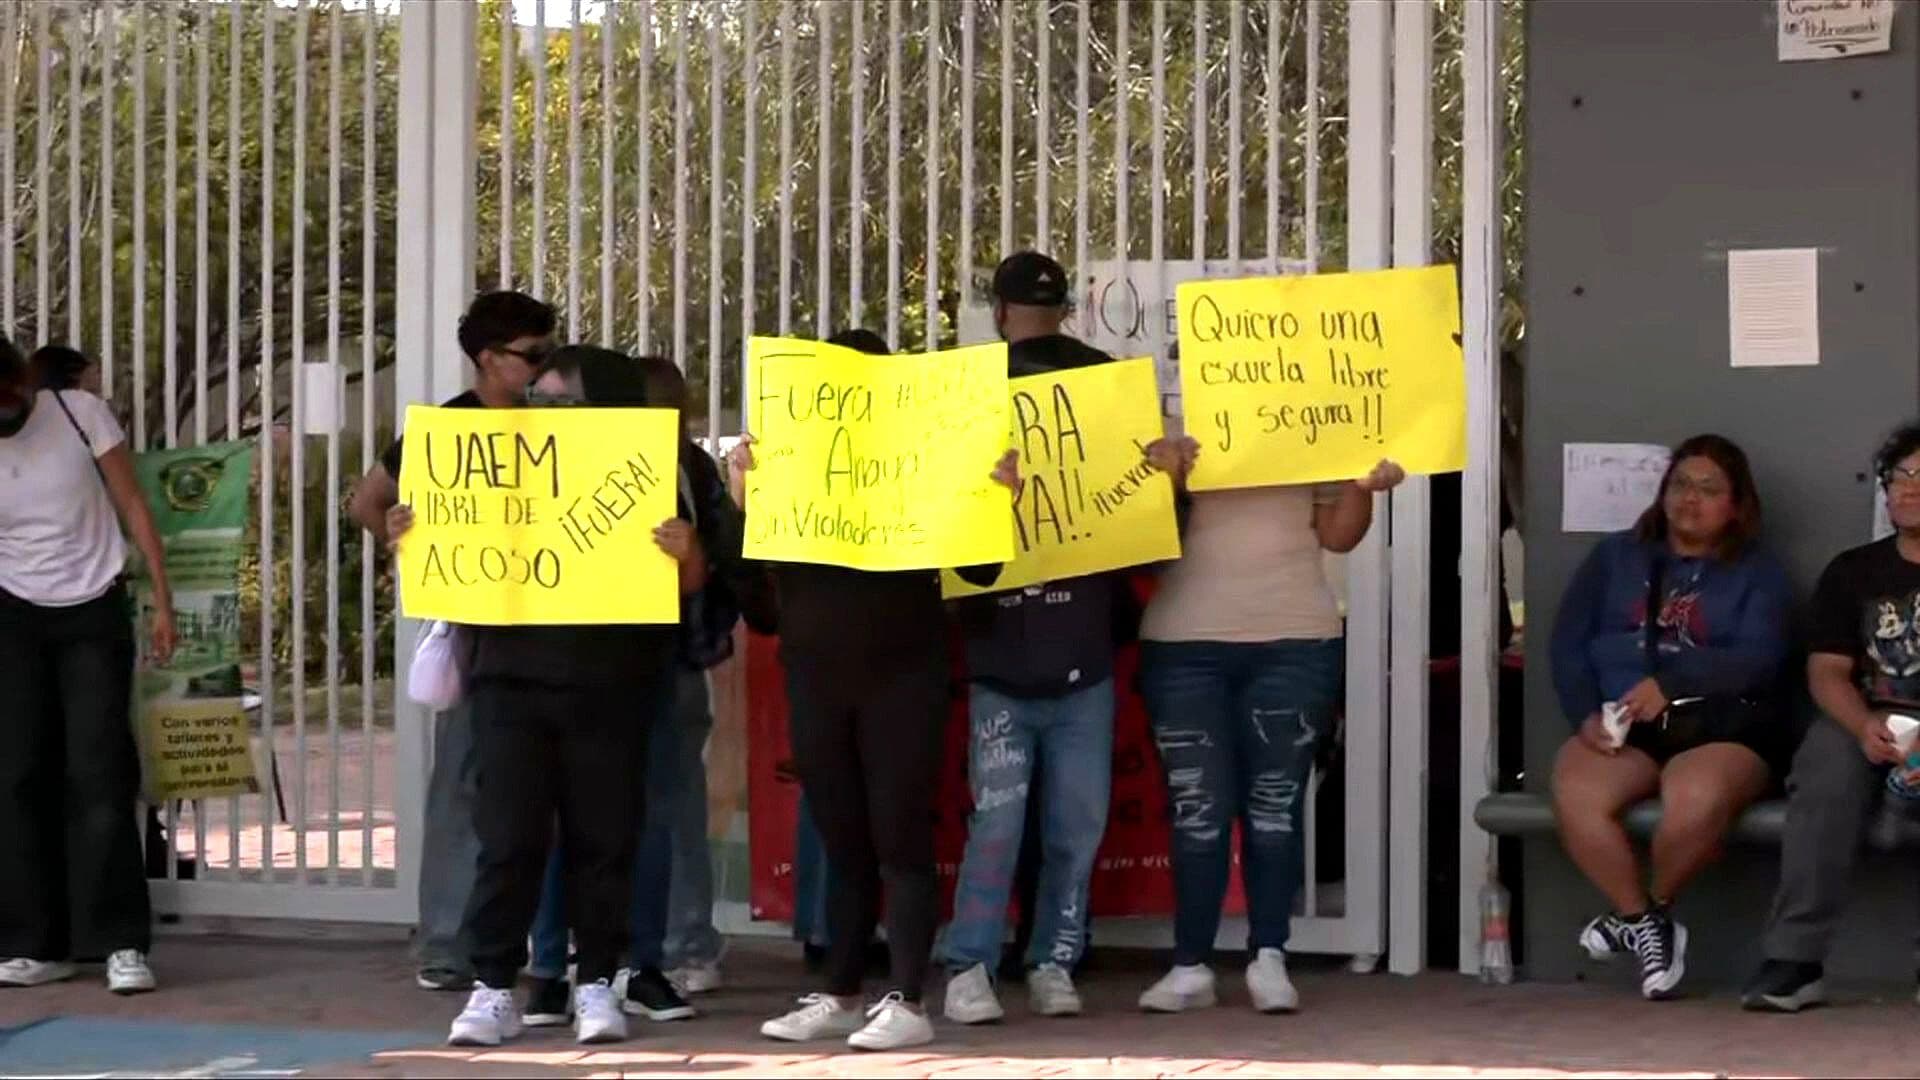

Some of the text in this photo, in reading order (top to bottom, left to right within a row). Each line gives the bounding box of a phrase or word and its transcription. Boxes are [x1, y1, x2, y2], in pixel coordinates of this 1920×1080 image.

[1191, 294, 1384, 348] Quiero una
[1200, 347, 1391, 388] escuela libre
[759, 353, 872, 439] Fuera
[1214, 408, 1232, 452] y
[425, 431, 560, 499] UAEM
[503, 495, 541, 526] DE
[421, 543, 561, 589] ACOSO
